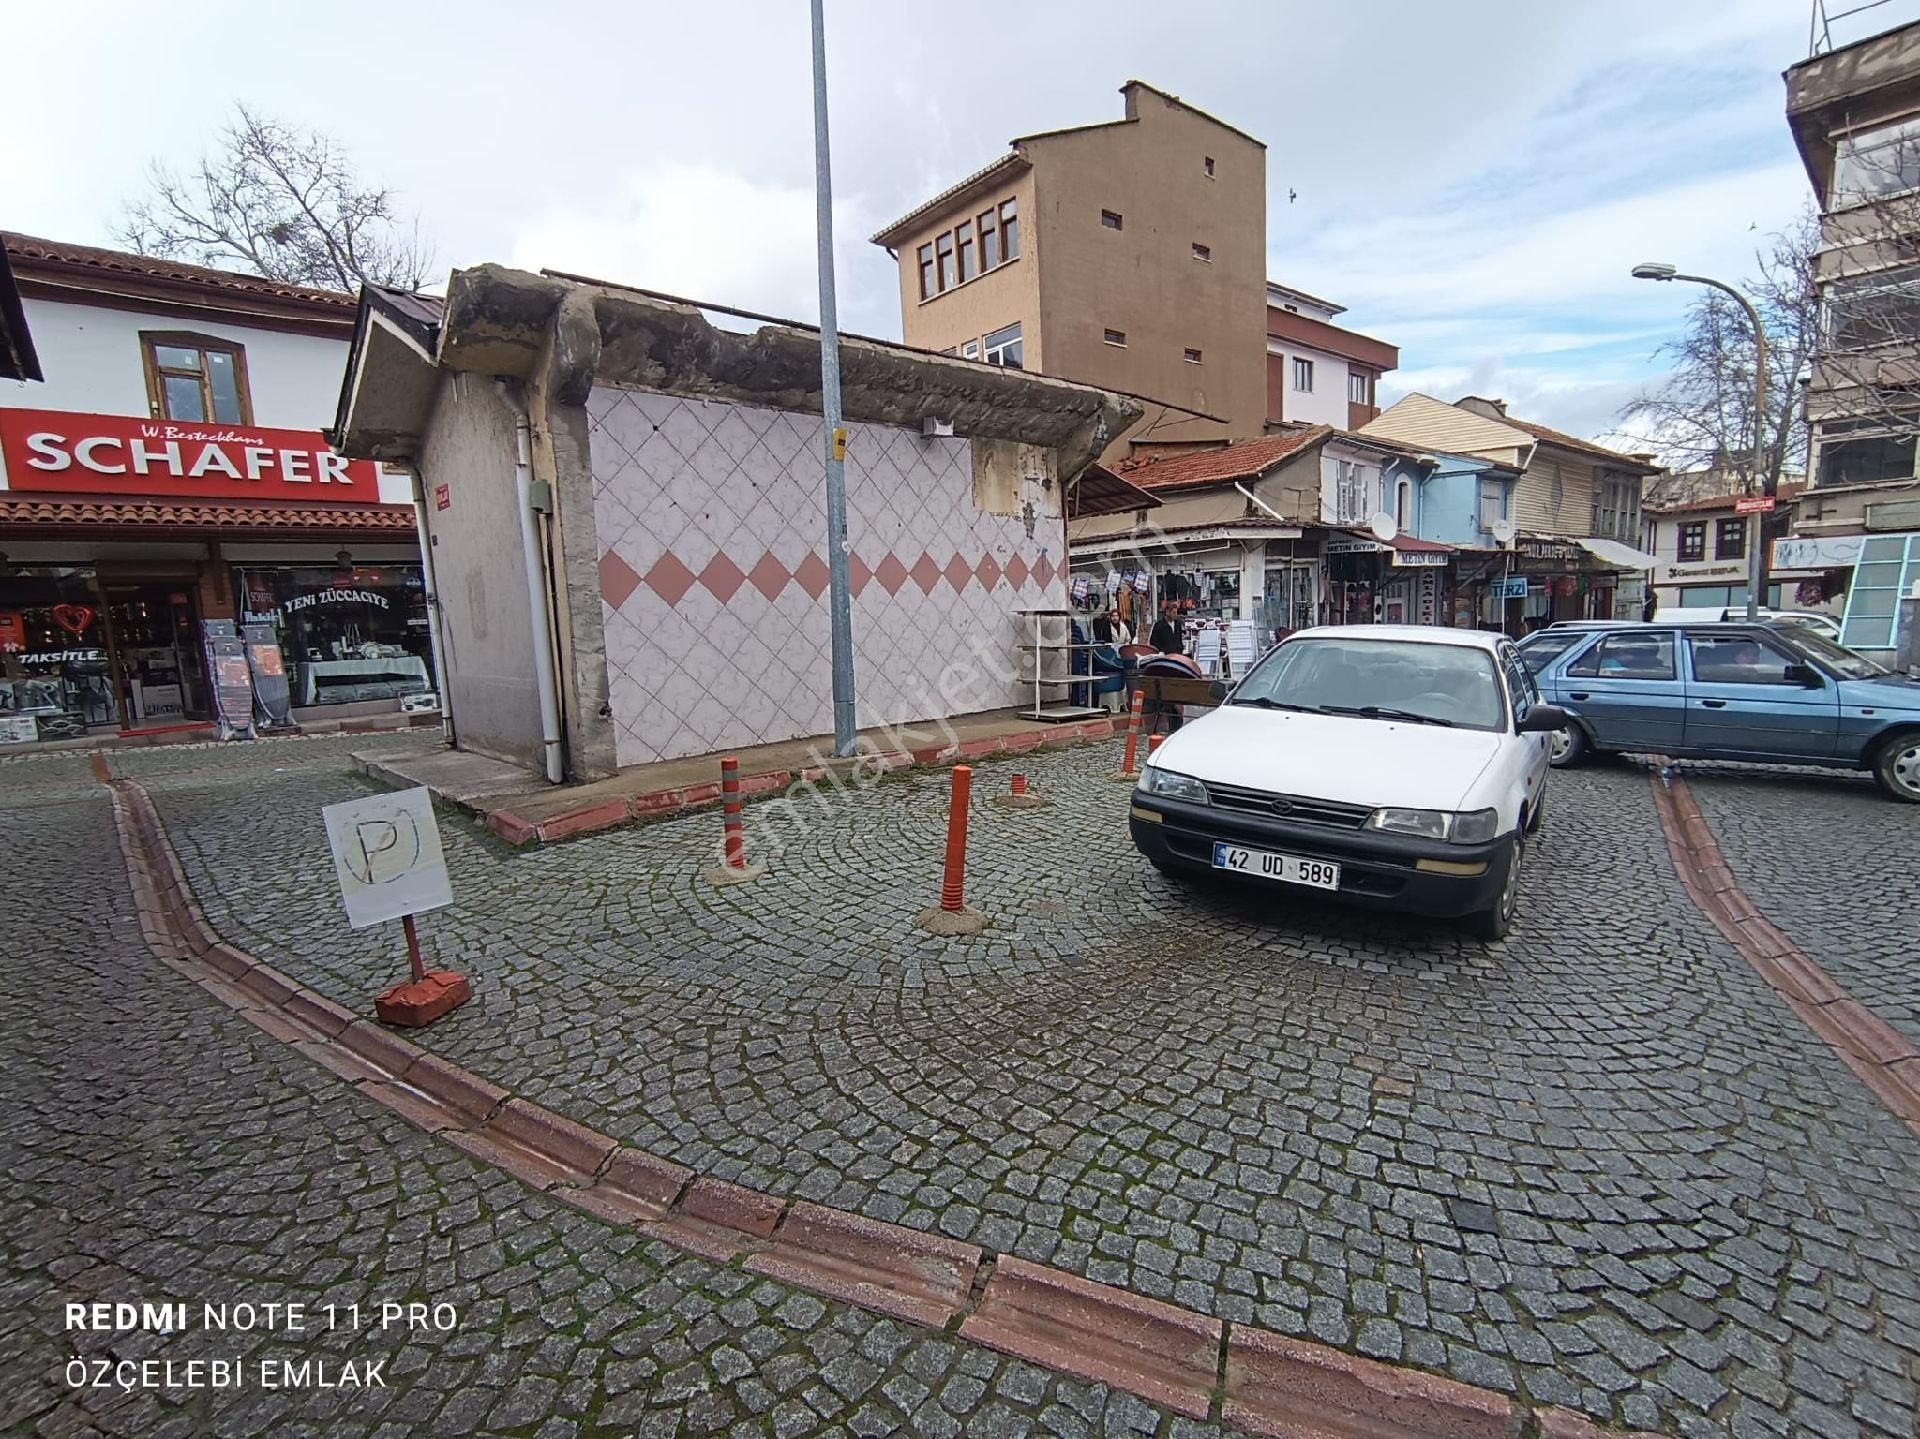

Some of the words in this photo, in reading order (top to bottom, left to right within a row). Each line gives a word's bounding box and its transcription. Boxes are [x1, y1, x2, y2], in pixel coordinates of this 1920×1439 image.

[26, 432, 354, 485] SCHAFER
[1492, 580, 1525, 597] TERZİ
[356, 820, 398, 883] P
[1228, 849, 1249, 870] 42
[1262, 854, 1284, 876] UD
[1299, 861, 1334, 885] 589
